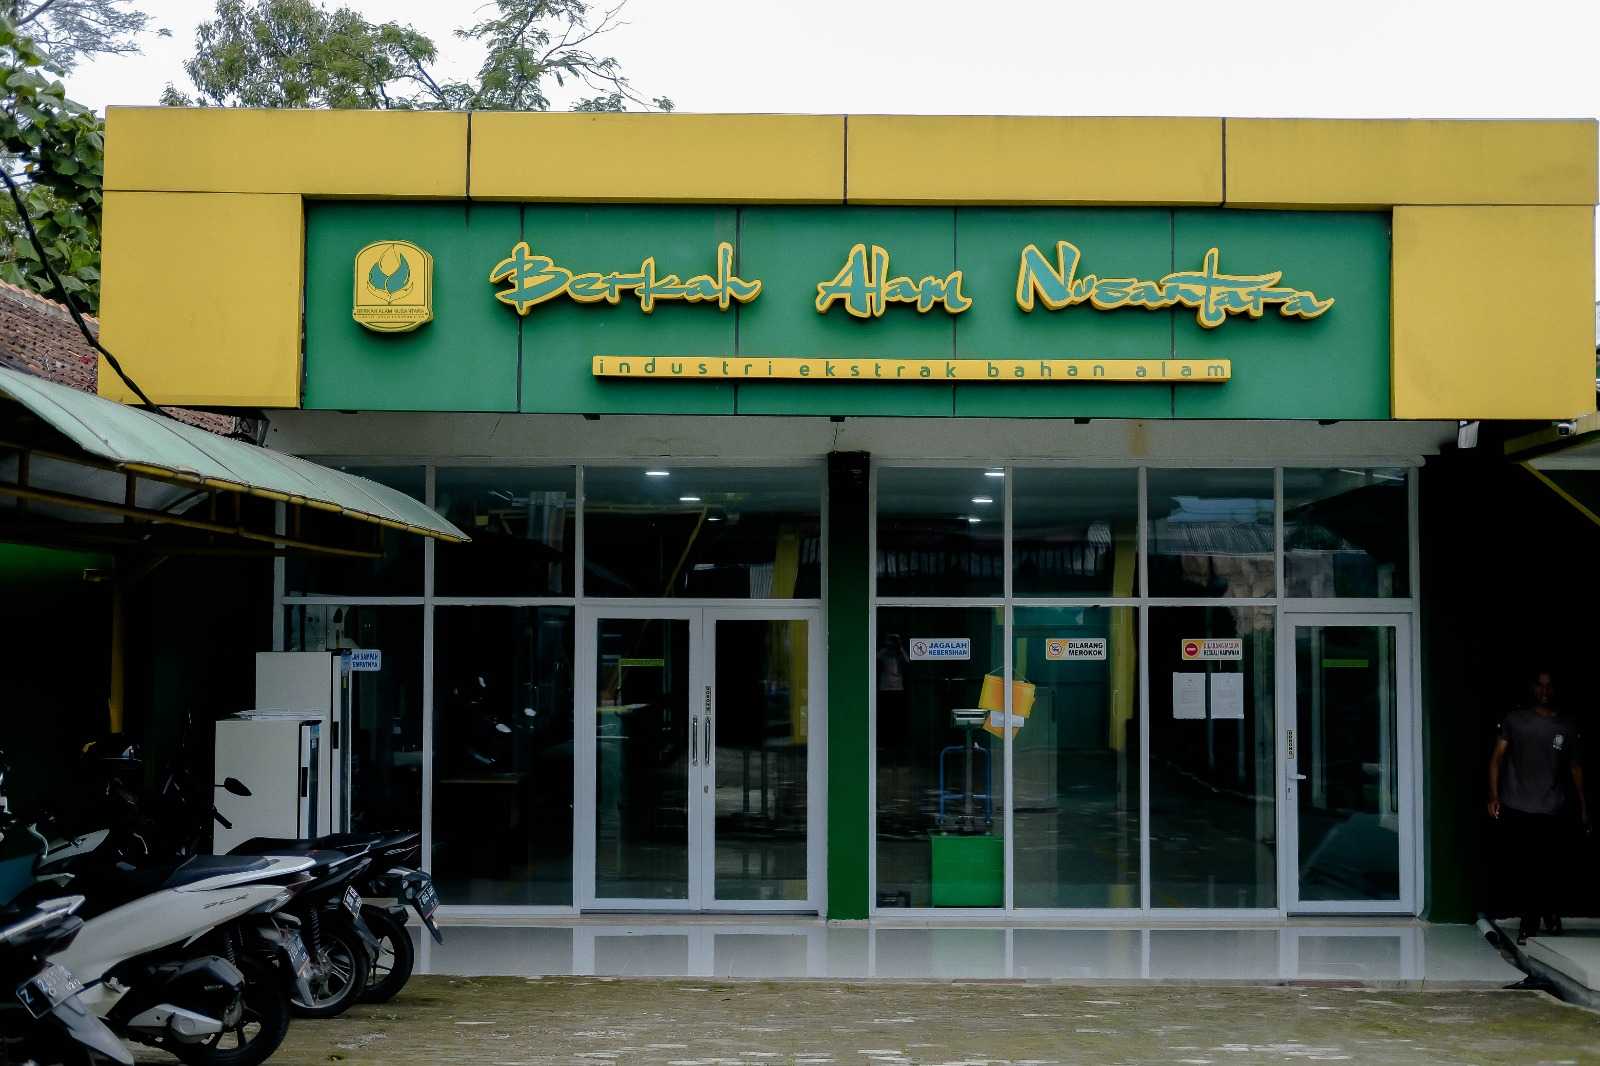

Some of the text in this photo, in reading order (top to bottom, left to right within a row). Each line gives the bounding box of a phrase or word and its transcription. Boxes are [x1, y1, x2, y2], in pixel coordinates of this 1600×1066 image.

[489, 239, 1336, 329] Berkah Alam Nusantara
[599, 357, 1226, 378] industri ekstrak bahan alam
